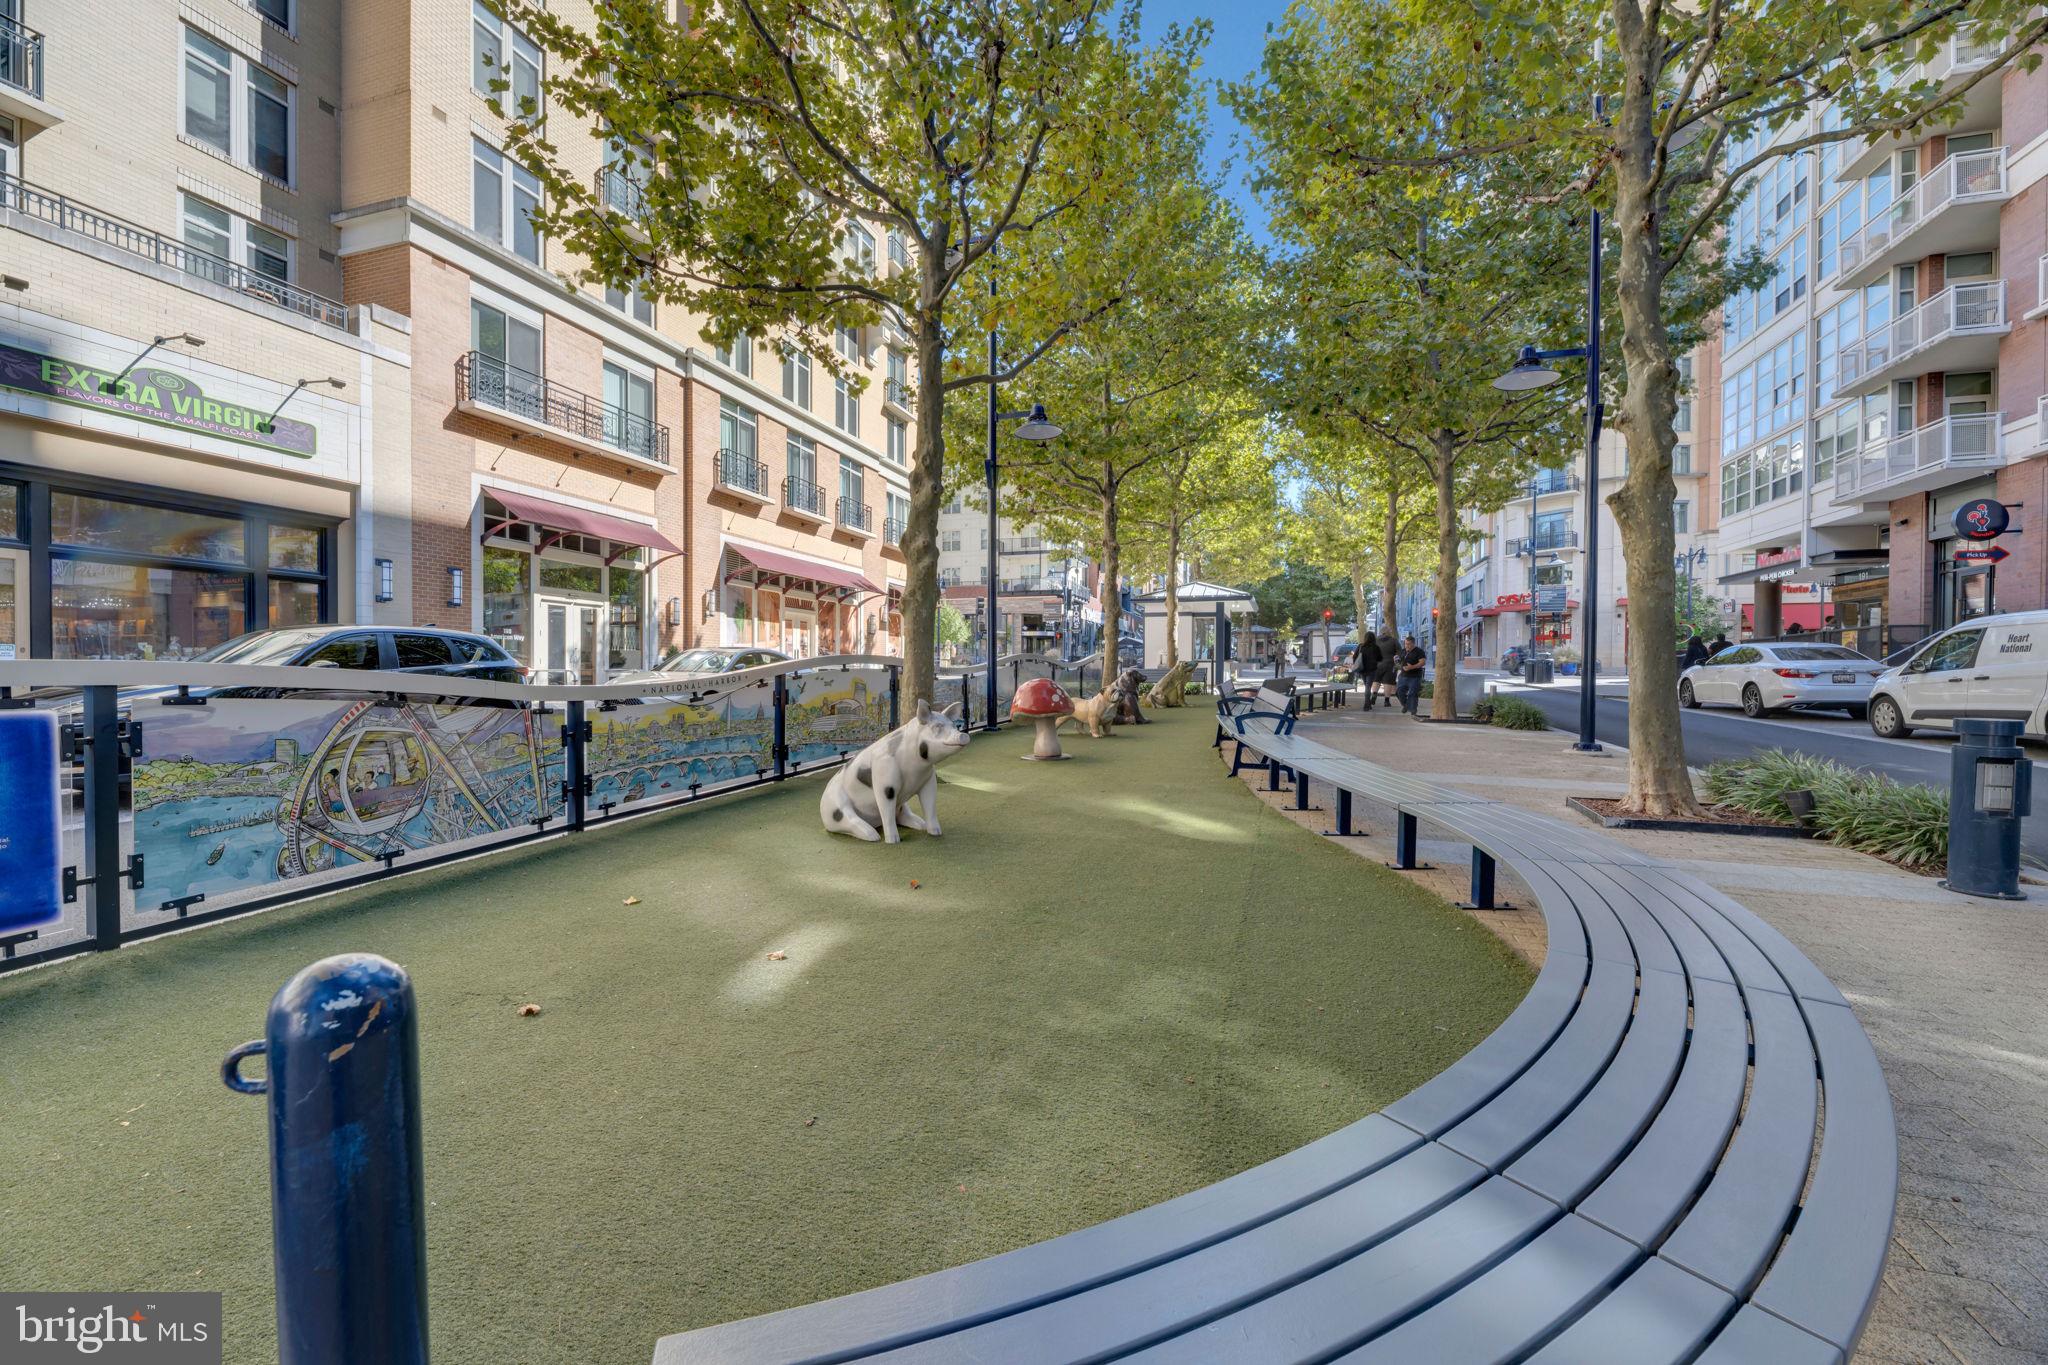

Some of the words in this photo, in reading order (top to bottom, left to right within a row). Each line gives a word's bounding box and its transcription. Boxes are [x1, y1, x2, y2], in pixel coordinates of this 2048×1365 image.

[41, 360, 161, 409] EXTRA
[171, 392, 272, 432] VIRGIN
[57, 387, 119, 407] FLAVORS
[124, 403, 142, 412] OF
[146, 408, 171, 419] THE
[174, 416, 219, 430] AMALFI
[221, 427, 260, 439] COAST
[2007, 633, 2030, 643] Heart
[1999, 643, 2032, 653] National
[650, 682, 702, 694] NATIONAL
[708, 675, 741, 687] HARBOR
